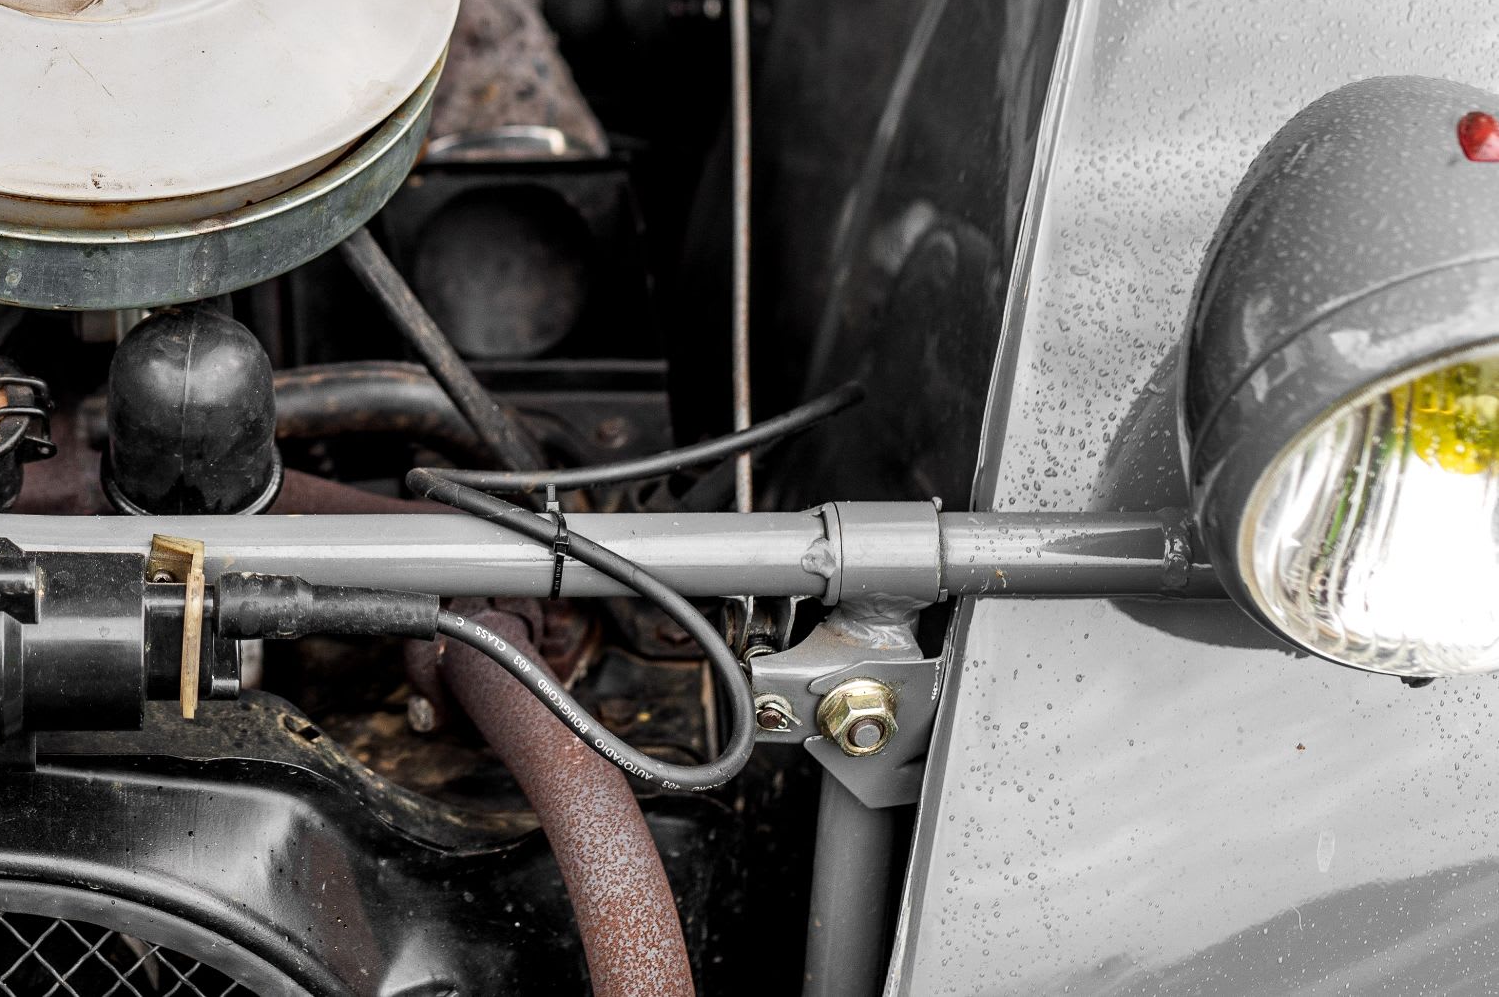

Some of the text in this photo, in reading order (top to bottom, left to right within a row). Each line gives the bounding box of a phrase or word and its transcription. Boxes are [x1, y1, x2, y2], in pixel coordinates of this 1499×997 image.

[455, 616, 465, 626] C
[475, 626, 507, 652] CLASS
[513, 655, 531, 673] 403
[537, 679, 590, 734] BOUGICORD
[594, 738, 654, 781] AUTORADIO
